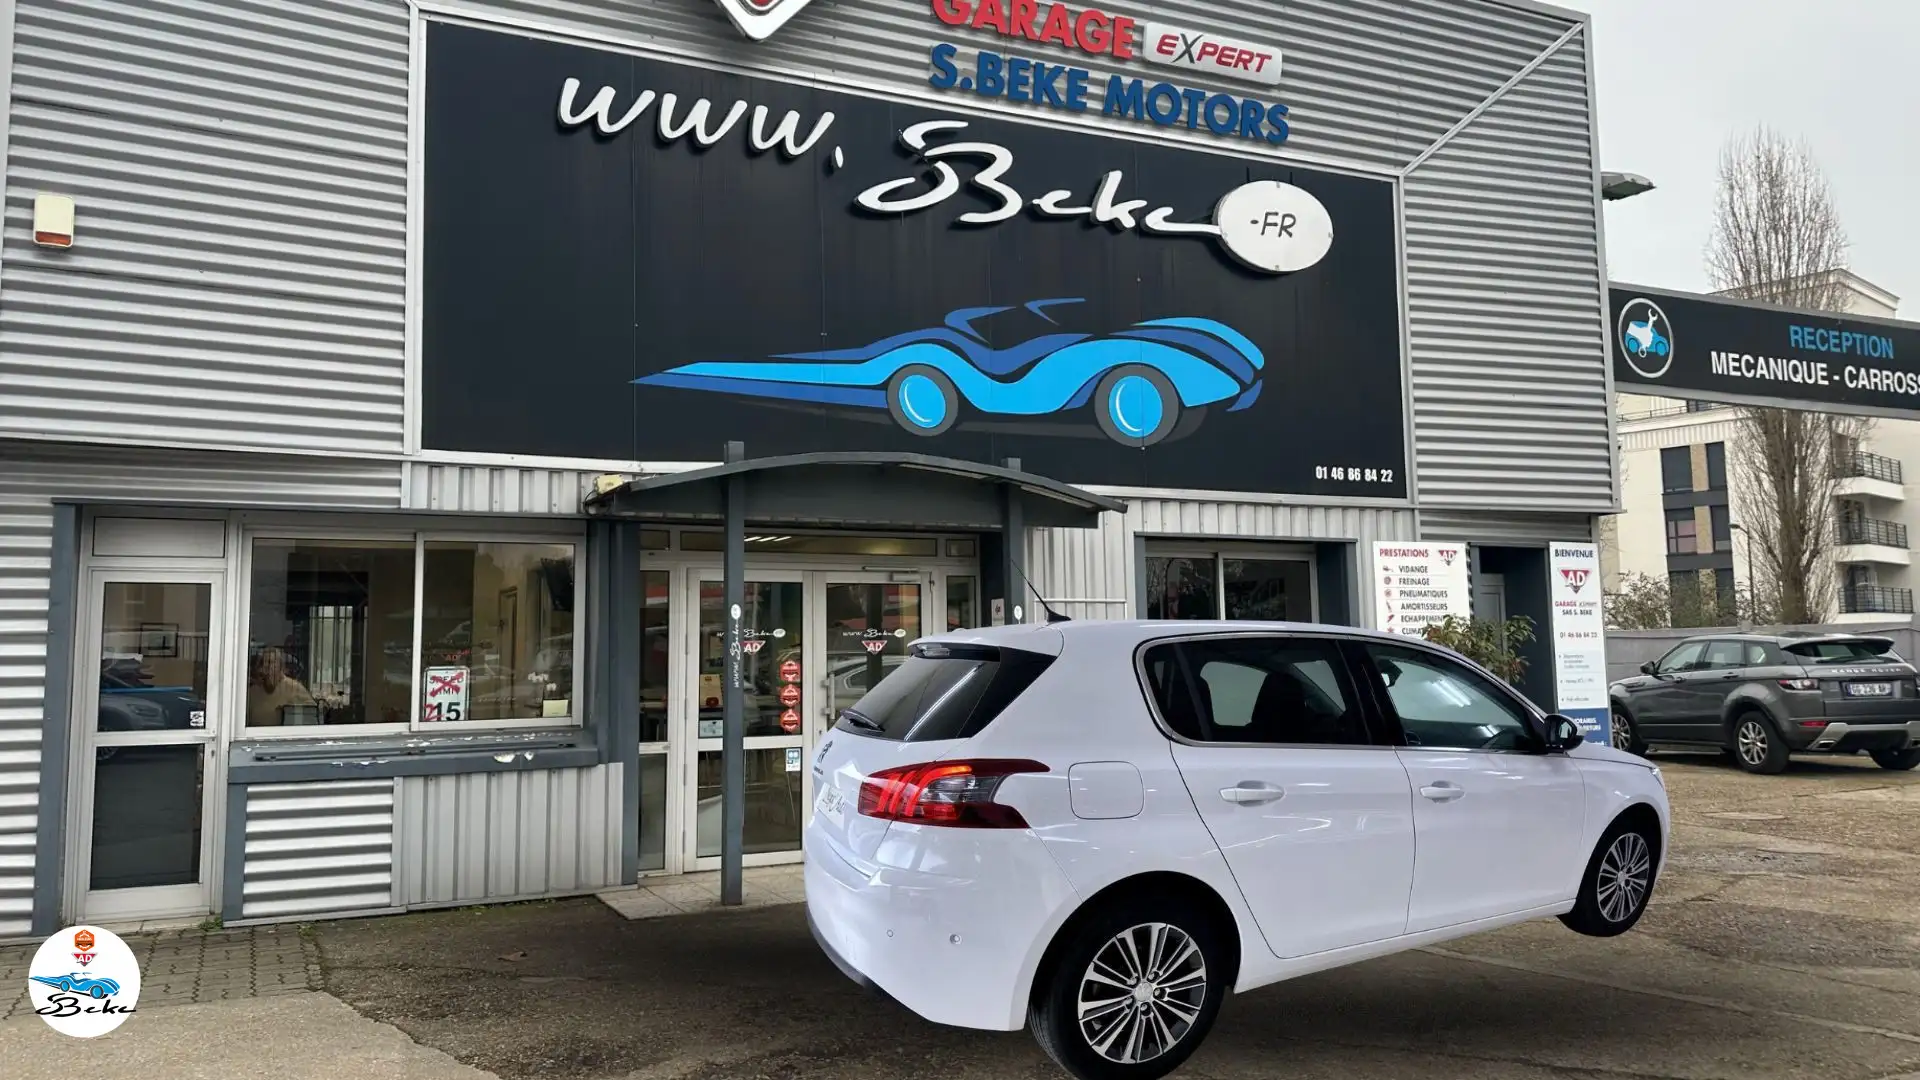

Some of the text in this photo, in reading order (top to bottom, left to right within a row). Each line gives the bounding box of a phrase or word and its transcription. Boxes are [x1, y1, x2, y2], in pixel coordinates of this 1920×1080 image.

[930, 0, 1135, 60] GARAGE
[928, 43, 1290, 145] S.BEKE MOTORS
[1788, 324, 1894, 360] RECEPTION
[1710, 350, 1830, 386] MECANIQUE
[1844, 366, 1920, 396] CARROS
[1315, 465, 1328, 480] 01
[1330, 467, 1344, 481] 46
[1364, 468, 1378, 482] 84
[1380, 469, 1393, 483] 22
[1379, 548, 1429, 558] PRESTATIONS
[1554, 548, 1593, 558] BIENVENUE
[1398, 565, 1428, 573] VIDANGE
[1398, 577, 1430, 586] FREINAGE
[1566, 570, 1585, 587] AD
[1399, 589, 1448, 598] PNEUMATIQUES
[1400, 602, 1448, 611] AMORTISSEURS
[744, 643, 760, 653] AD
